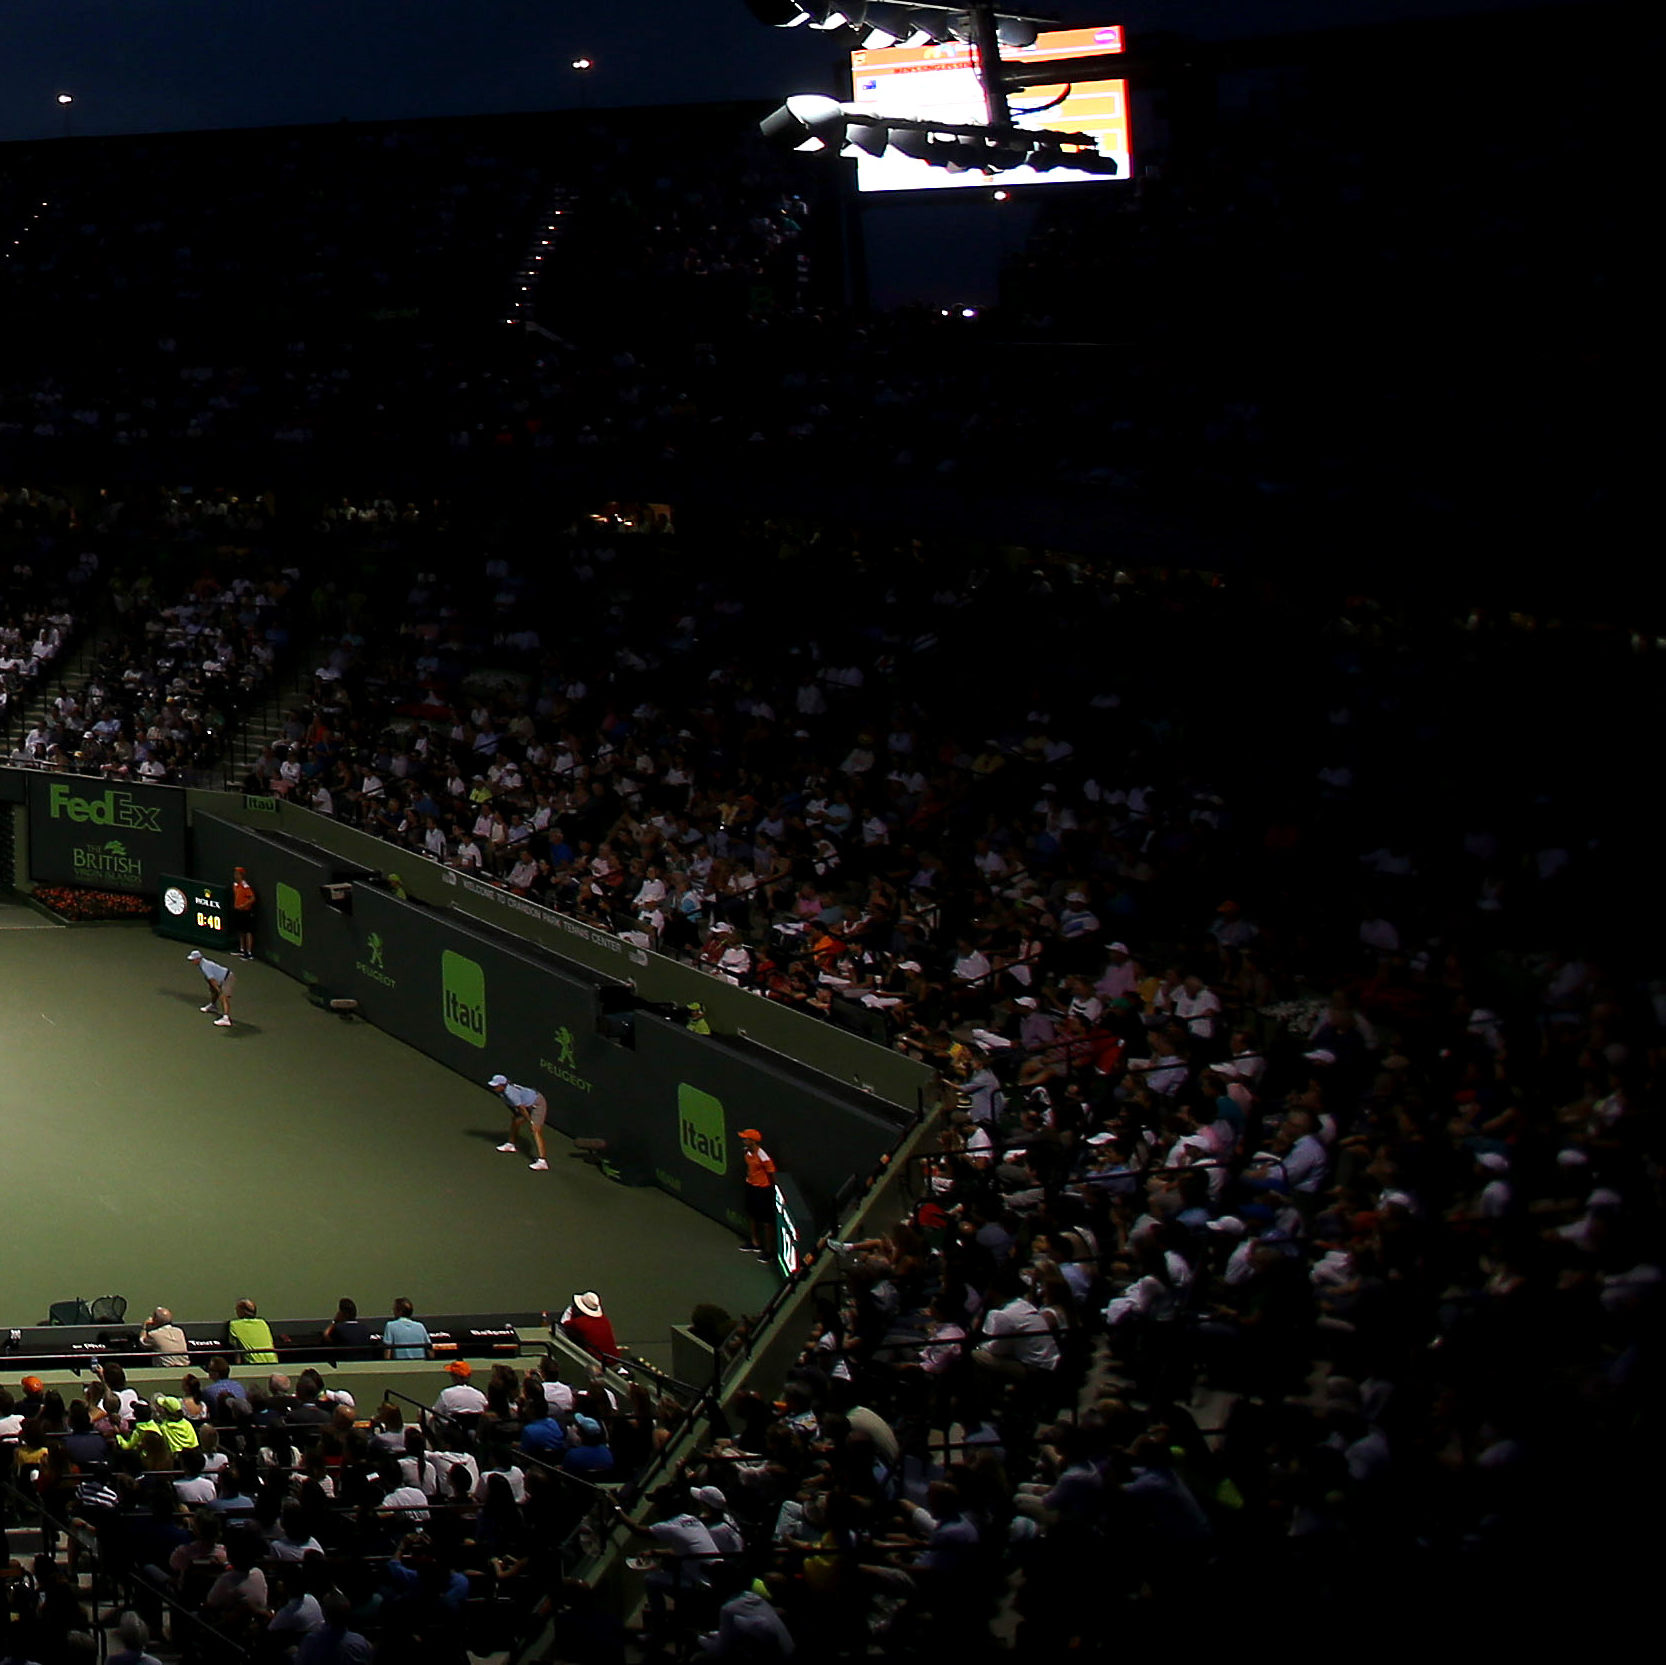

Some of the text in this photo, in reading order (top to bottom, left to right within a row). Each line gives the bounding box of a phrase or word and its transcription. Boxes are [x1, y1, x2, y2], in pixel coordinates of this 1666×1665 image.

[50, 784, 162, 832] FedEx
[249, 797, 275, 811] Itaú
[73, 847, 142, 876] BRITISH
[195, 897, 221, 909] ROLEX
[197, 912, 222, 930] 0:40
[278, 908, 301, 936] Itaú
[591, 932, 622, 953] CENTER
[356, 961, 397, 989] PEUGEOT
[445, 989, 484, 1035] Itaú
[540, 1058, 594, 1093] PEUGEOT
[682, 1118, 723, 1164] Itaú
